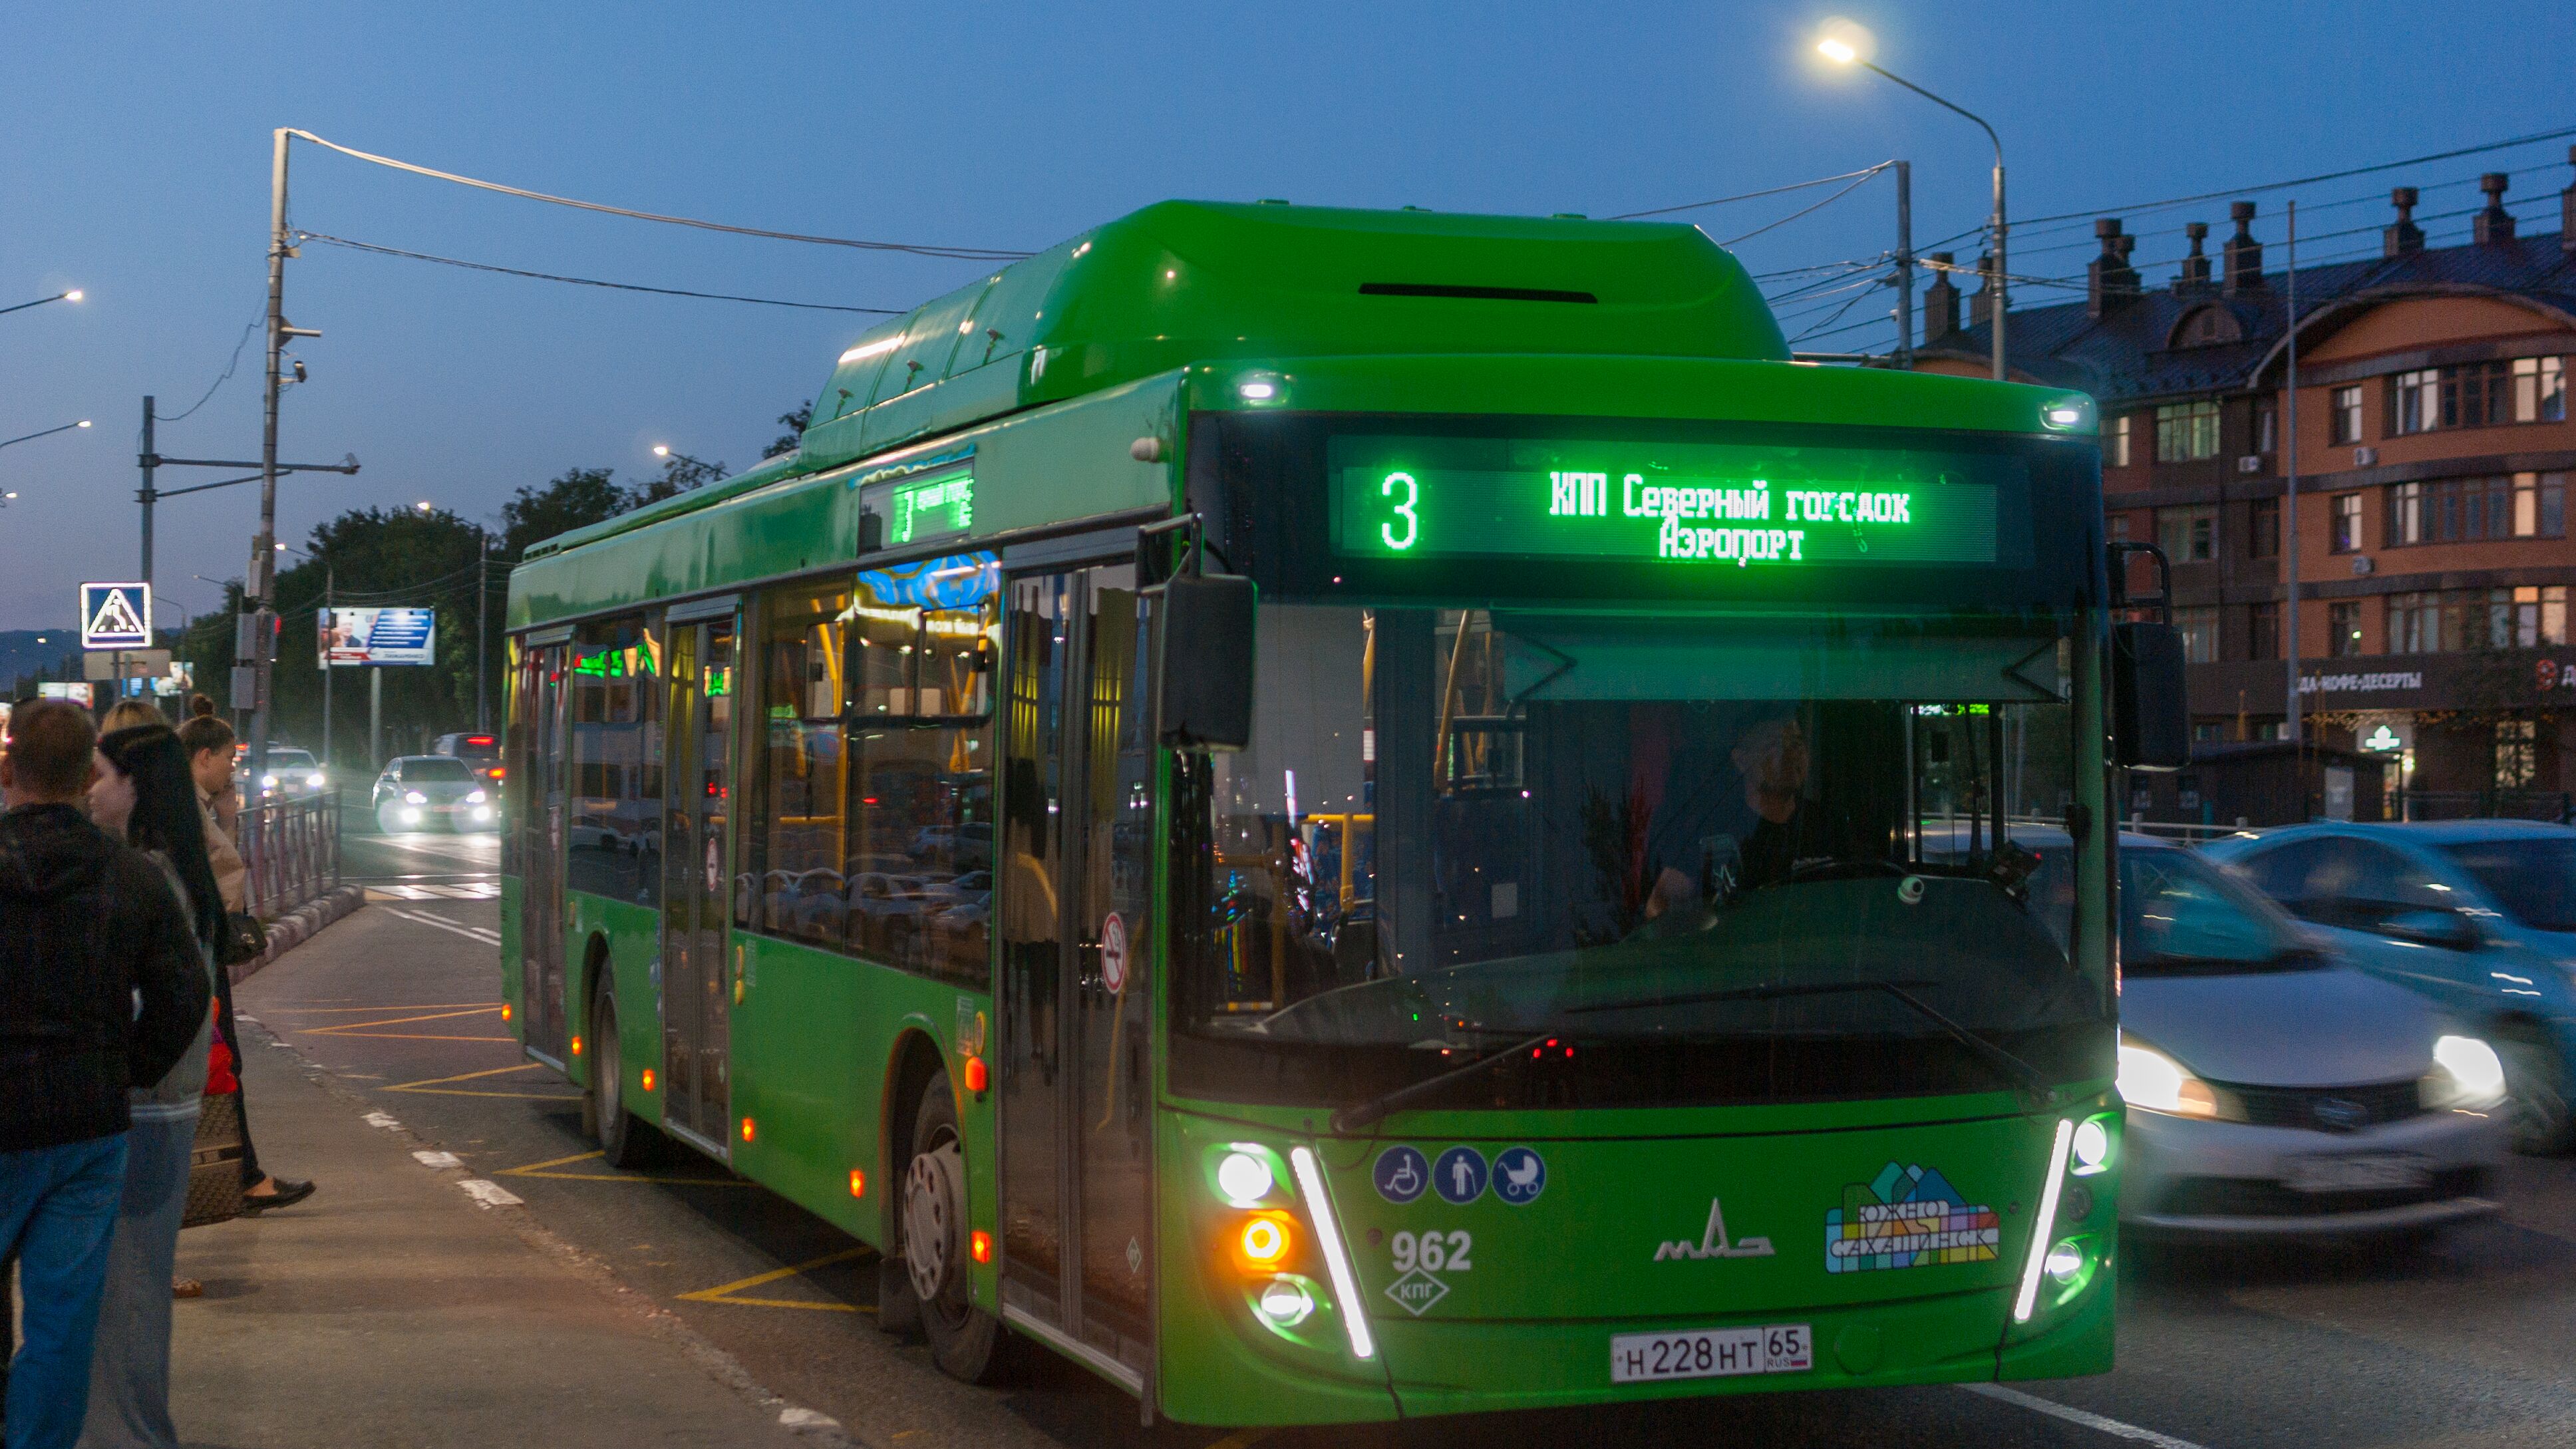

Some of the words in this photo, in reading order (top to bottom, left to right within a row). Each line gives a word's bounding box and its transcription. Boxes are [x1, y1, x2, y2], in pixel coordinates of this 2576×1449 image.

[1382, 472, 1417, 550] 3
[1549, 472, 1607, 516] КПП
[1623, 474, 1770, 520] Северный
[1659, 515, 1804, 560] Аэропорт
[1391, 1230, 1472, 1272] 962
[1400, 1283, 1434, 1299] КПГ
[1766, 1358, 1790, 1368] RUS
[1768, 1330, 1800, 1356] 65
